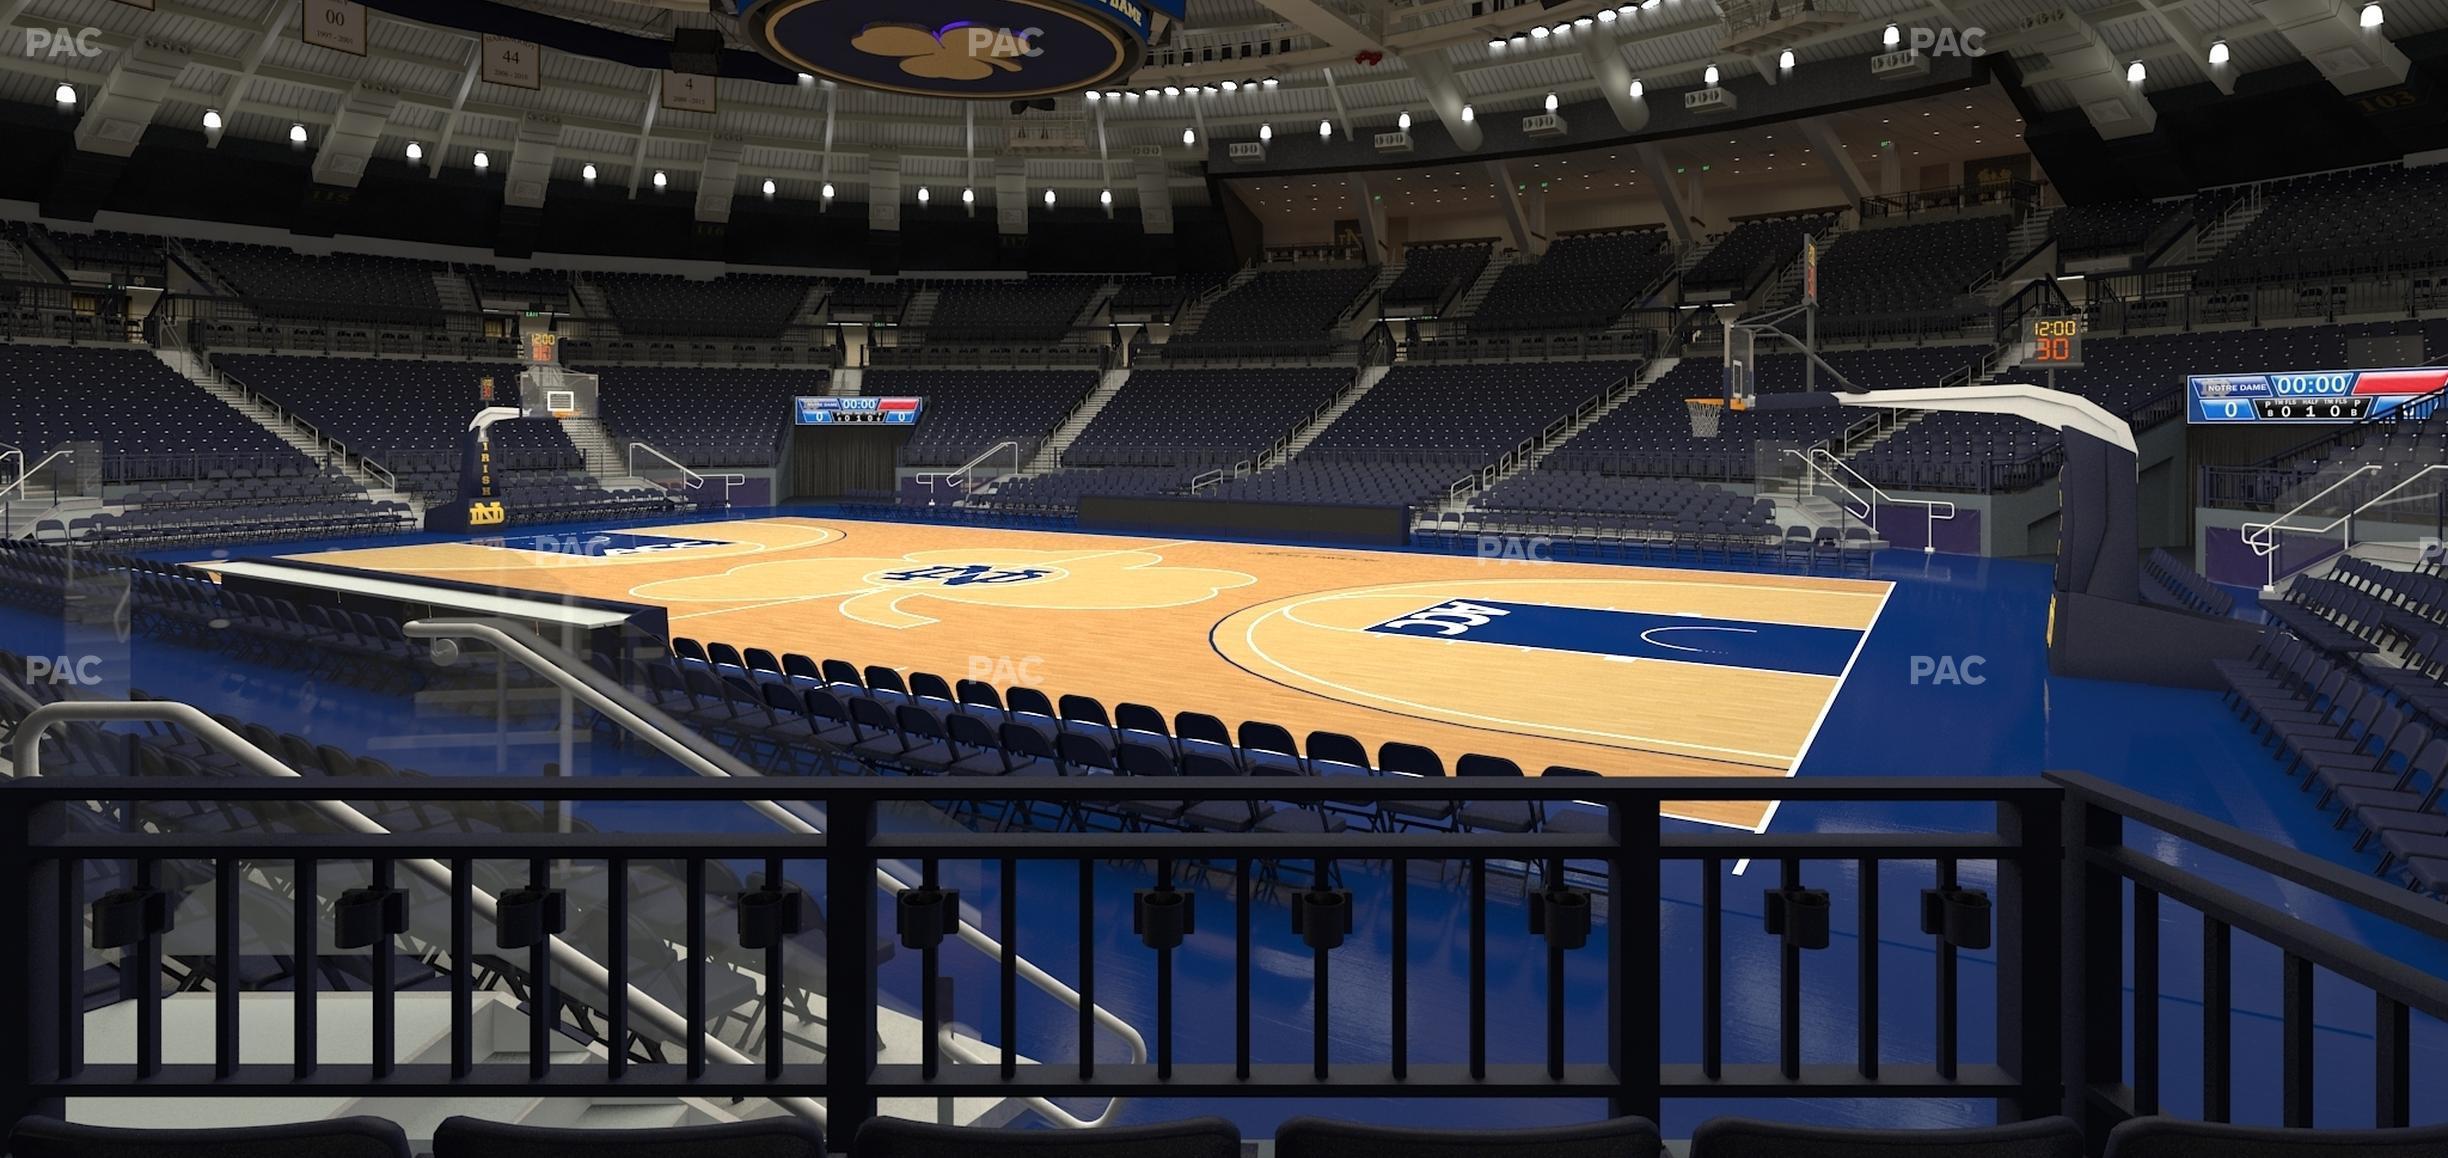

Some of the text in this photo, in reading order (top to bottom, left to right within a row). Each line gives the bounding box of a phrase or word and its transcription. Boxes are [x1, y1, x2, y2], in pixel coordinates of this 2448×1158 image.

[326, 9, 345, 26] 00
[503, 50, 520, 64] 44
[685, 78, 693, 90] 4
[2035, 320, 2076, 336] 12:00
[2036, 338, 2070, 360] 30
[2208, 383, 2267, 392] NOTRE DAME
[2277, 375, 2346, 394] 00:00
[843, 400, 875, 409] 00:00
[2224, 402, 2238, 418] 0
[2281, 405, 2291, 417] 0
[2306, 405, 2316, 417] 1
[2330, 404, 2341, 417] 0
[816, 412, 823, 422] 0
[898, 411, 906, 422] 0
[481, 442, 491, 496] IRISH
[1384, 600, 1512, 636] ACC
